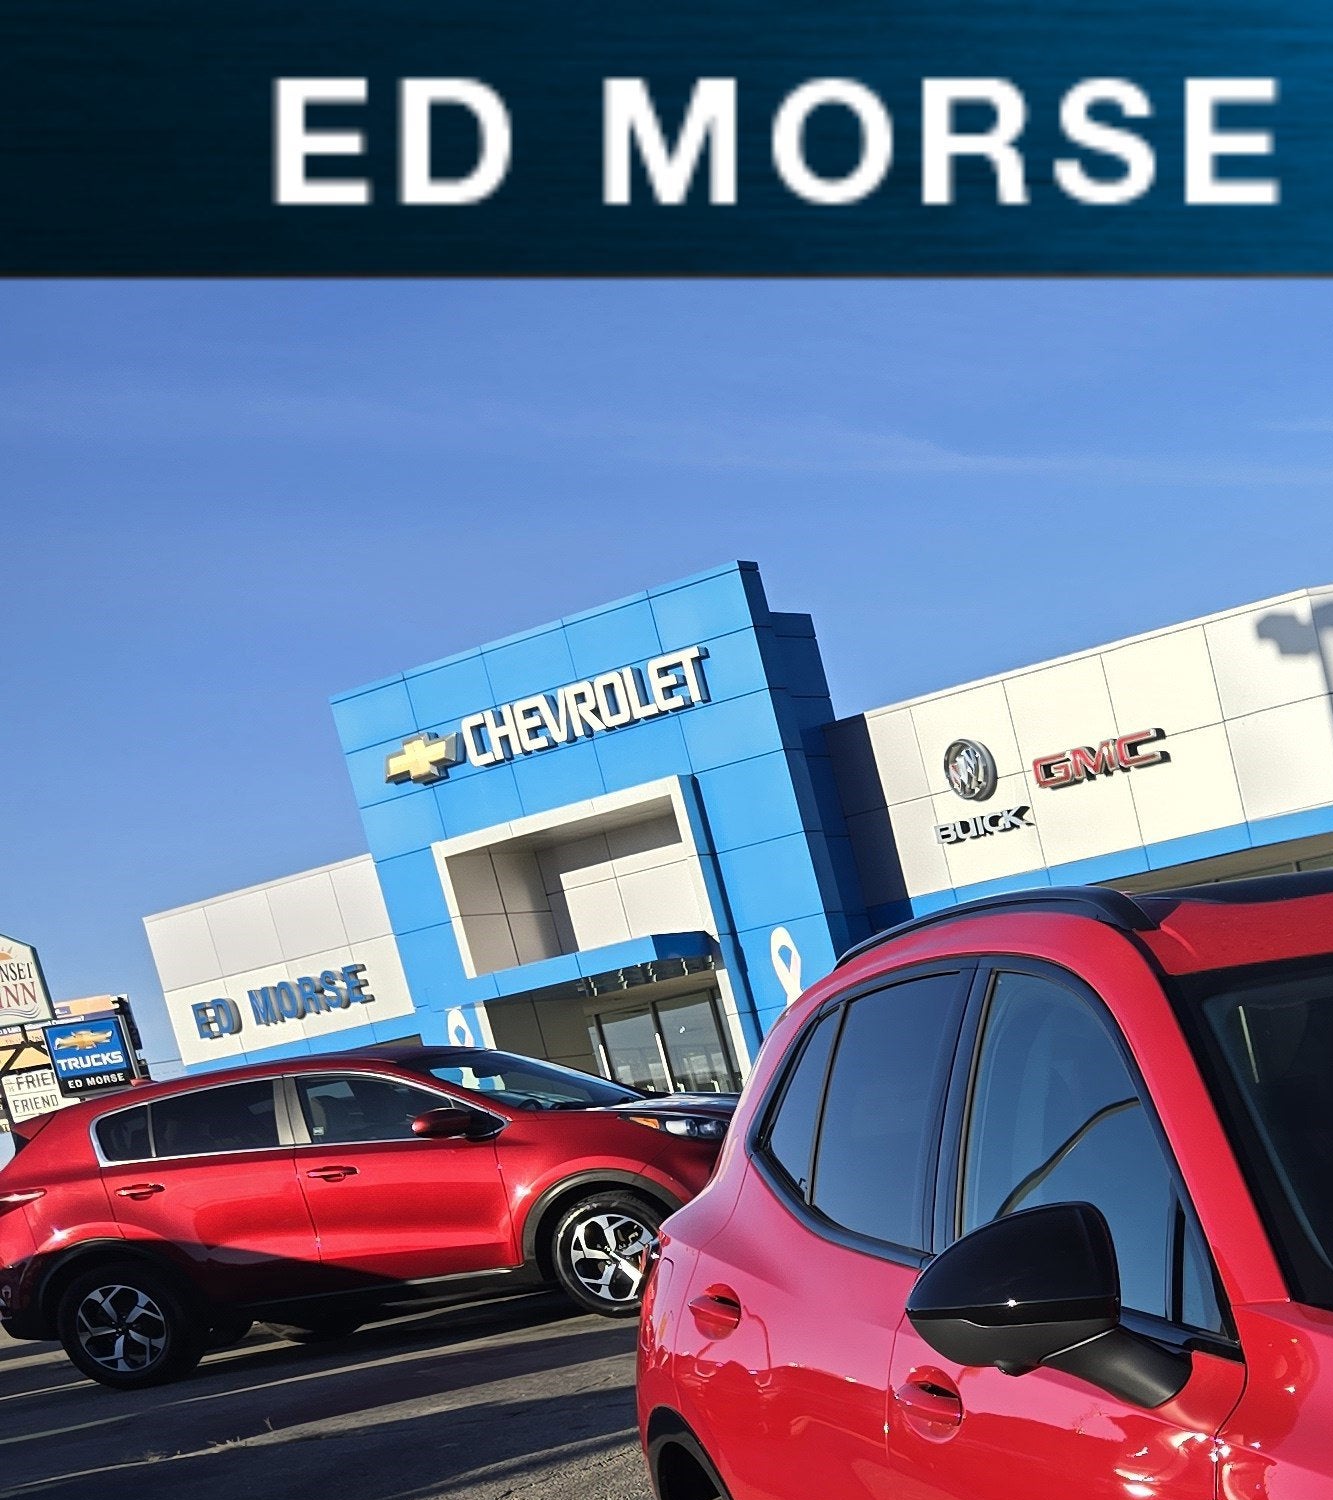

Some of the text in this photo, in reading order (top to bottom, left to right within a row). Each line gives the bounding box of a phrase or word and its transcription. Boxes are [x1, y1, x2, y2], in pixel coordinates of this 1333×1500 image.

[461, 645, 709, 767] CHEVROLET
[1032, 729, 1168, 789] GMC
[934, 805, 1034, 844] BUICK
[191, 964, 374, 1039] ED MORSE
[57, 1050, 124, 1071] TRUCKS
[68, 1072, 125, 1089] ED MORSE
[13, 1094, 59, 1114] FRIEND
